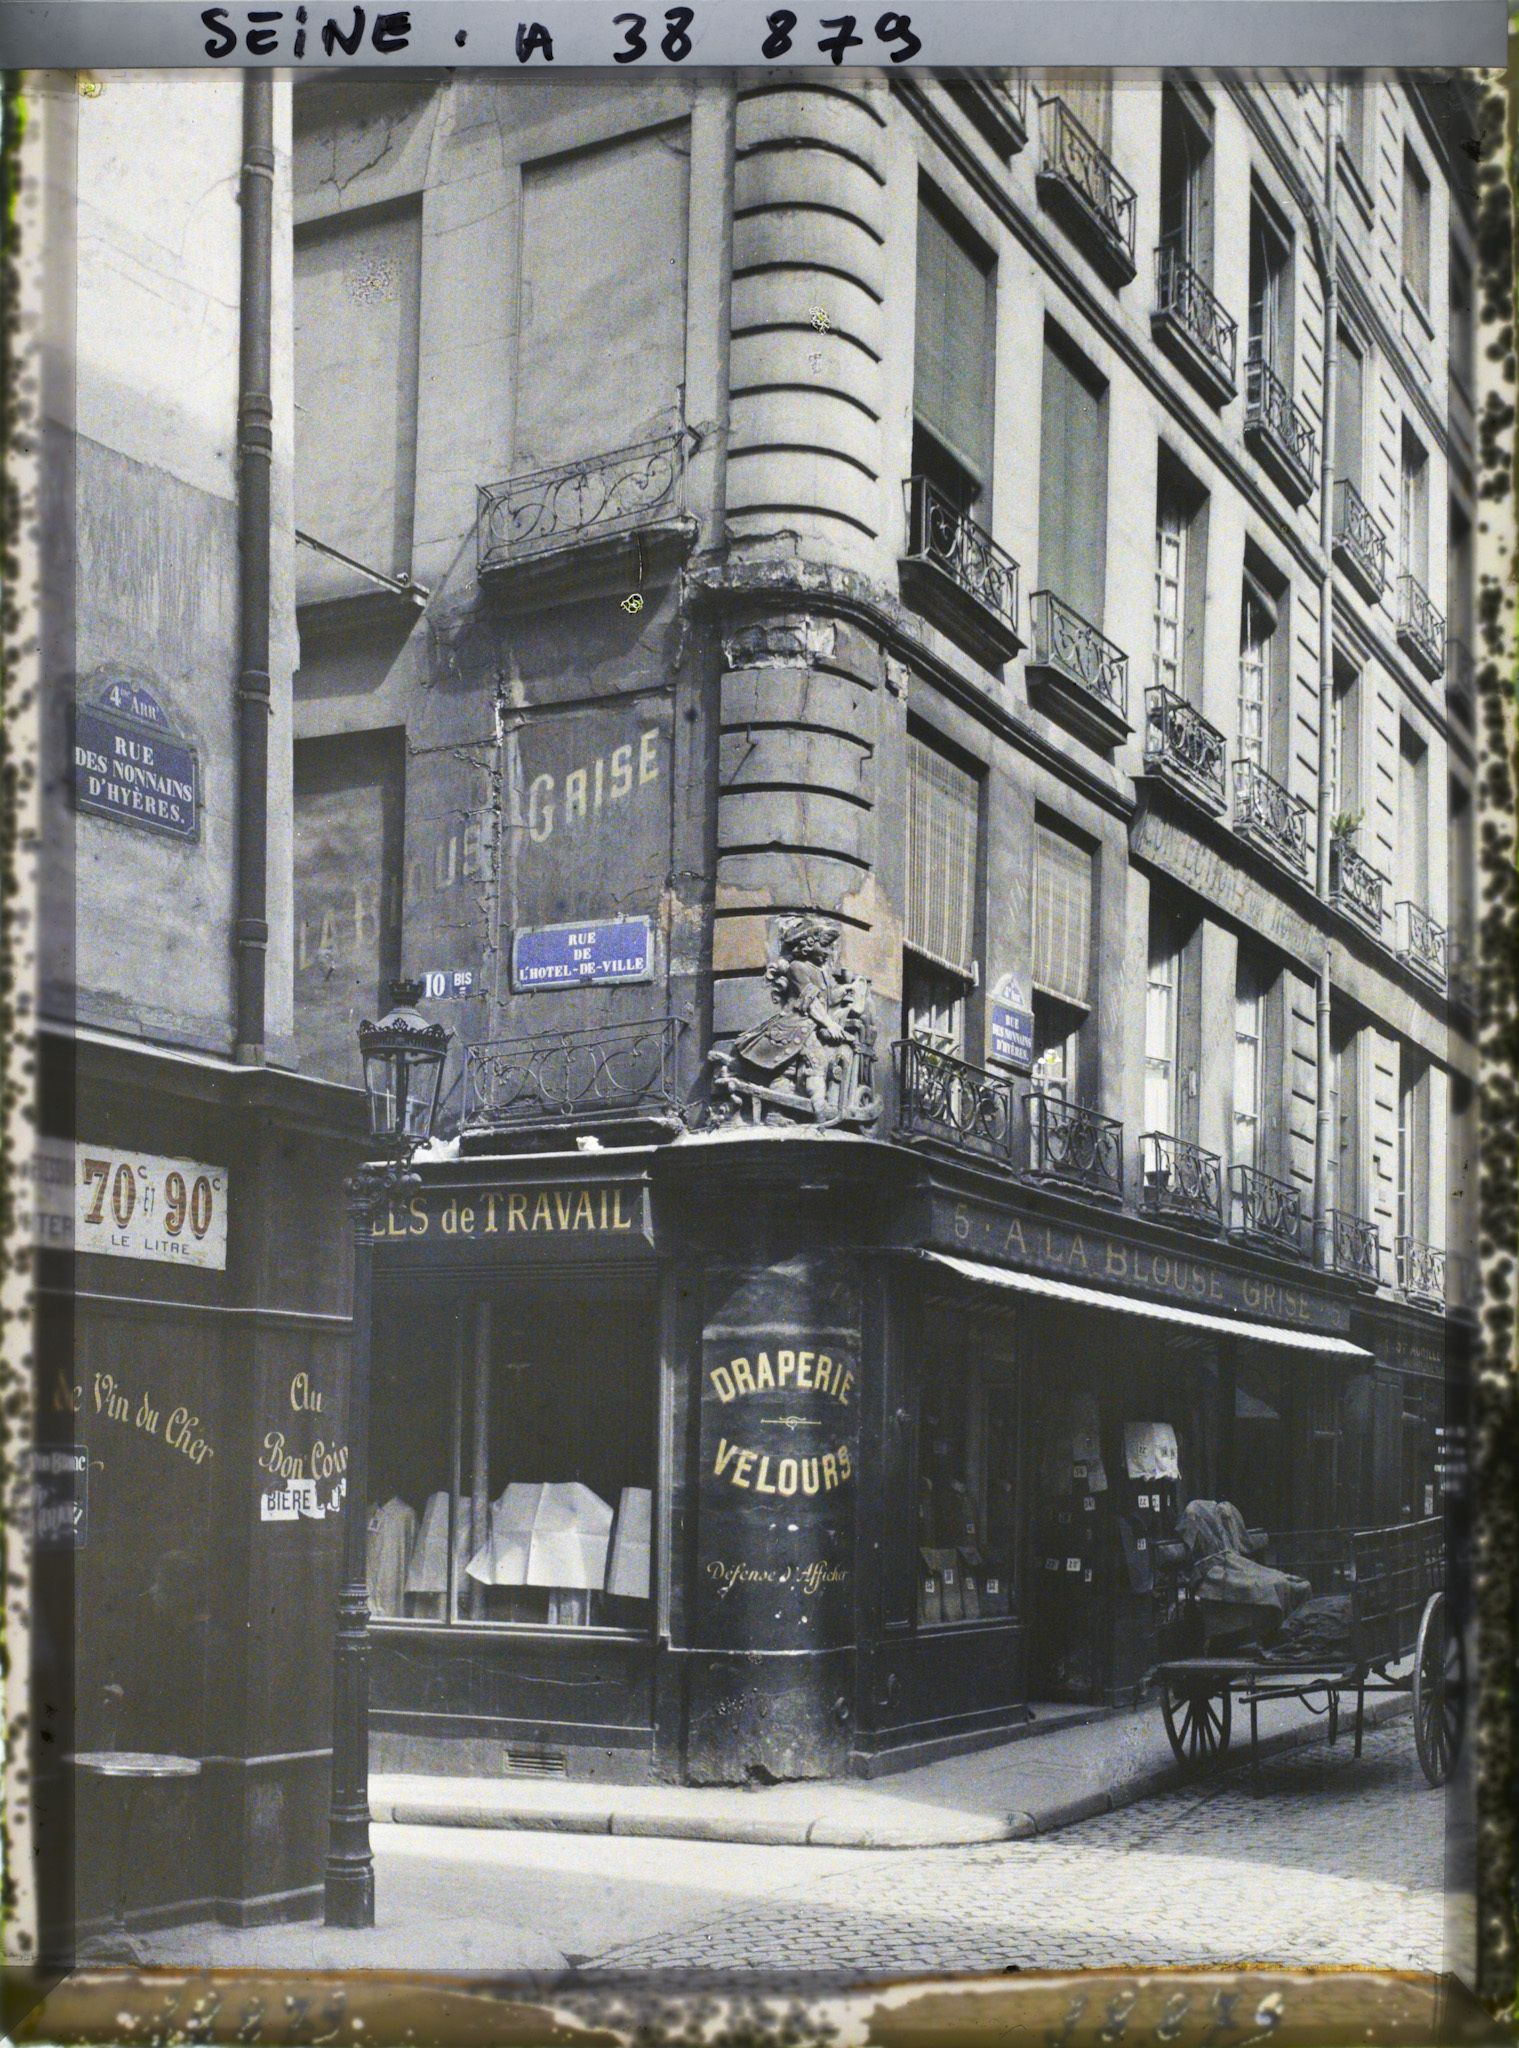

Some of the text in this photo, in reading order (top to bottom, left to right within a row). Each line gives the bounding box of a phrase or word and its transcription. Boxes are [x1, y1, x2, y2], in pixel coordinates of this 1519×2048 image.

[517, 22, 554, 63] A
[613, 9, 693, 62] 38
[761, 8, 923, 64] 879
[115, 736, 154, 766] RUE
[75, 746, 192, 802] DES NONNAINS
[568, 931, 596, 947] RUE
[573, 947, 592, 961] DE
[425, 971, 473, 998] 10 BIS
[519, 958, 645, 982] L'HOTEL-DE-VILLE
[441, 1199, 475, 1234] de
[480, 1189, 632, 1233] TRAVAIL
[111, 1235, 190, 1255] LE LITRE
[954, 1204, 969, 1240] 5
[1003, 1218, 1026, 1254] A
[1046, 1228, 1088, 1269] LA
[1104, 1243, 1224, 1301] BLOUSE
[1242, 1278, 1310, 1320] GRISE
[290, 1371, 323, 1413] Au
[710, 1350, 855, 1405] DRAPERIE
[94, 1371, 129, 1423] Vin
[136, 1391, 159, 1435] du
[165, 1407, 214, 1466] Cher
[259, 1431, 304, 1481] Bon
[714, 1438, 851, 1496] VELOURS
